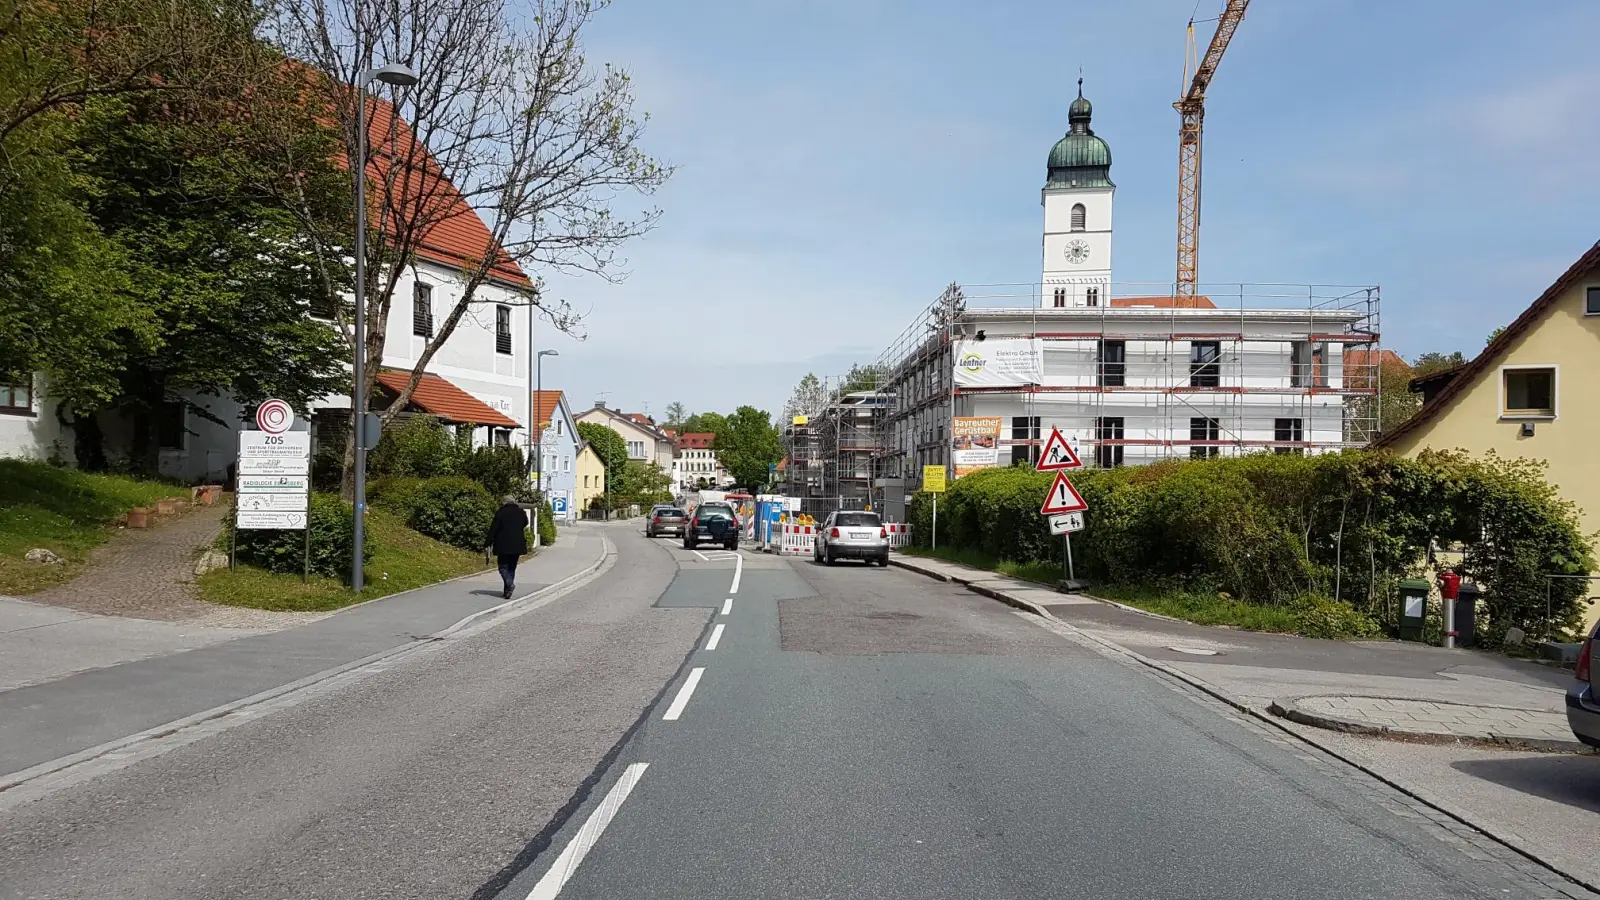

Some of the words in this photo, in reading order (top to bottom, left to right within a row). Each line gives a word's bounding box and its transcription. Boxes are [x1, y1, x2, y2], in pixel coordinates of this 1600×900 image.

[959, 358, 986, 366] Lentner
[954, 419, 1000, 427] Bayreuther
[954, 426, 996, 435] Gerüstbau
[265, 436, 284, 445] ZOS
[555, 501, 563, 511] P
